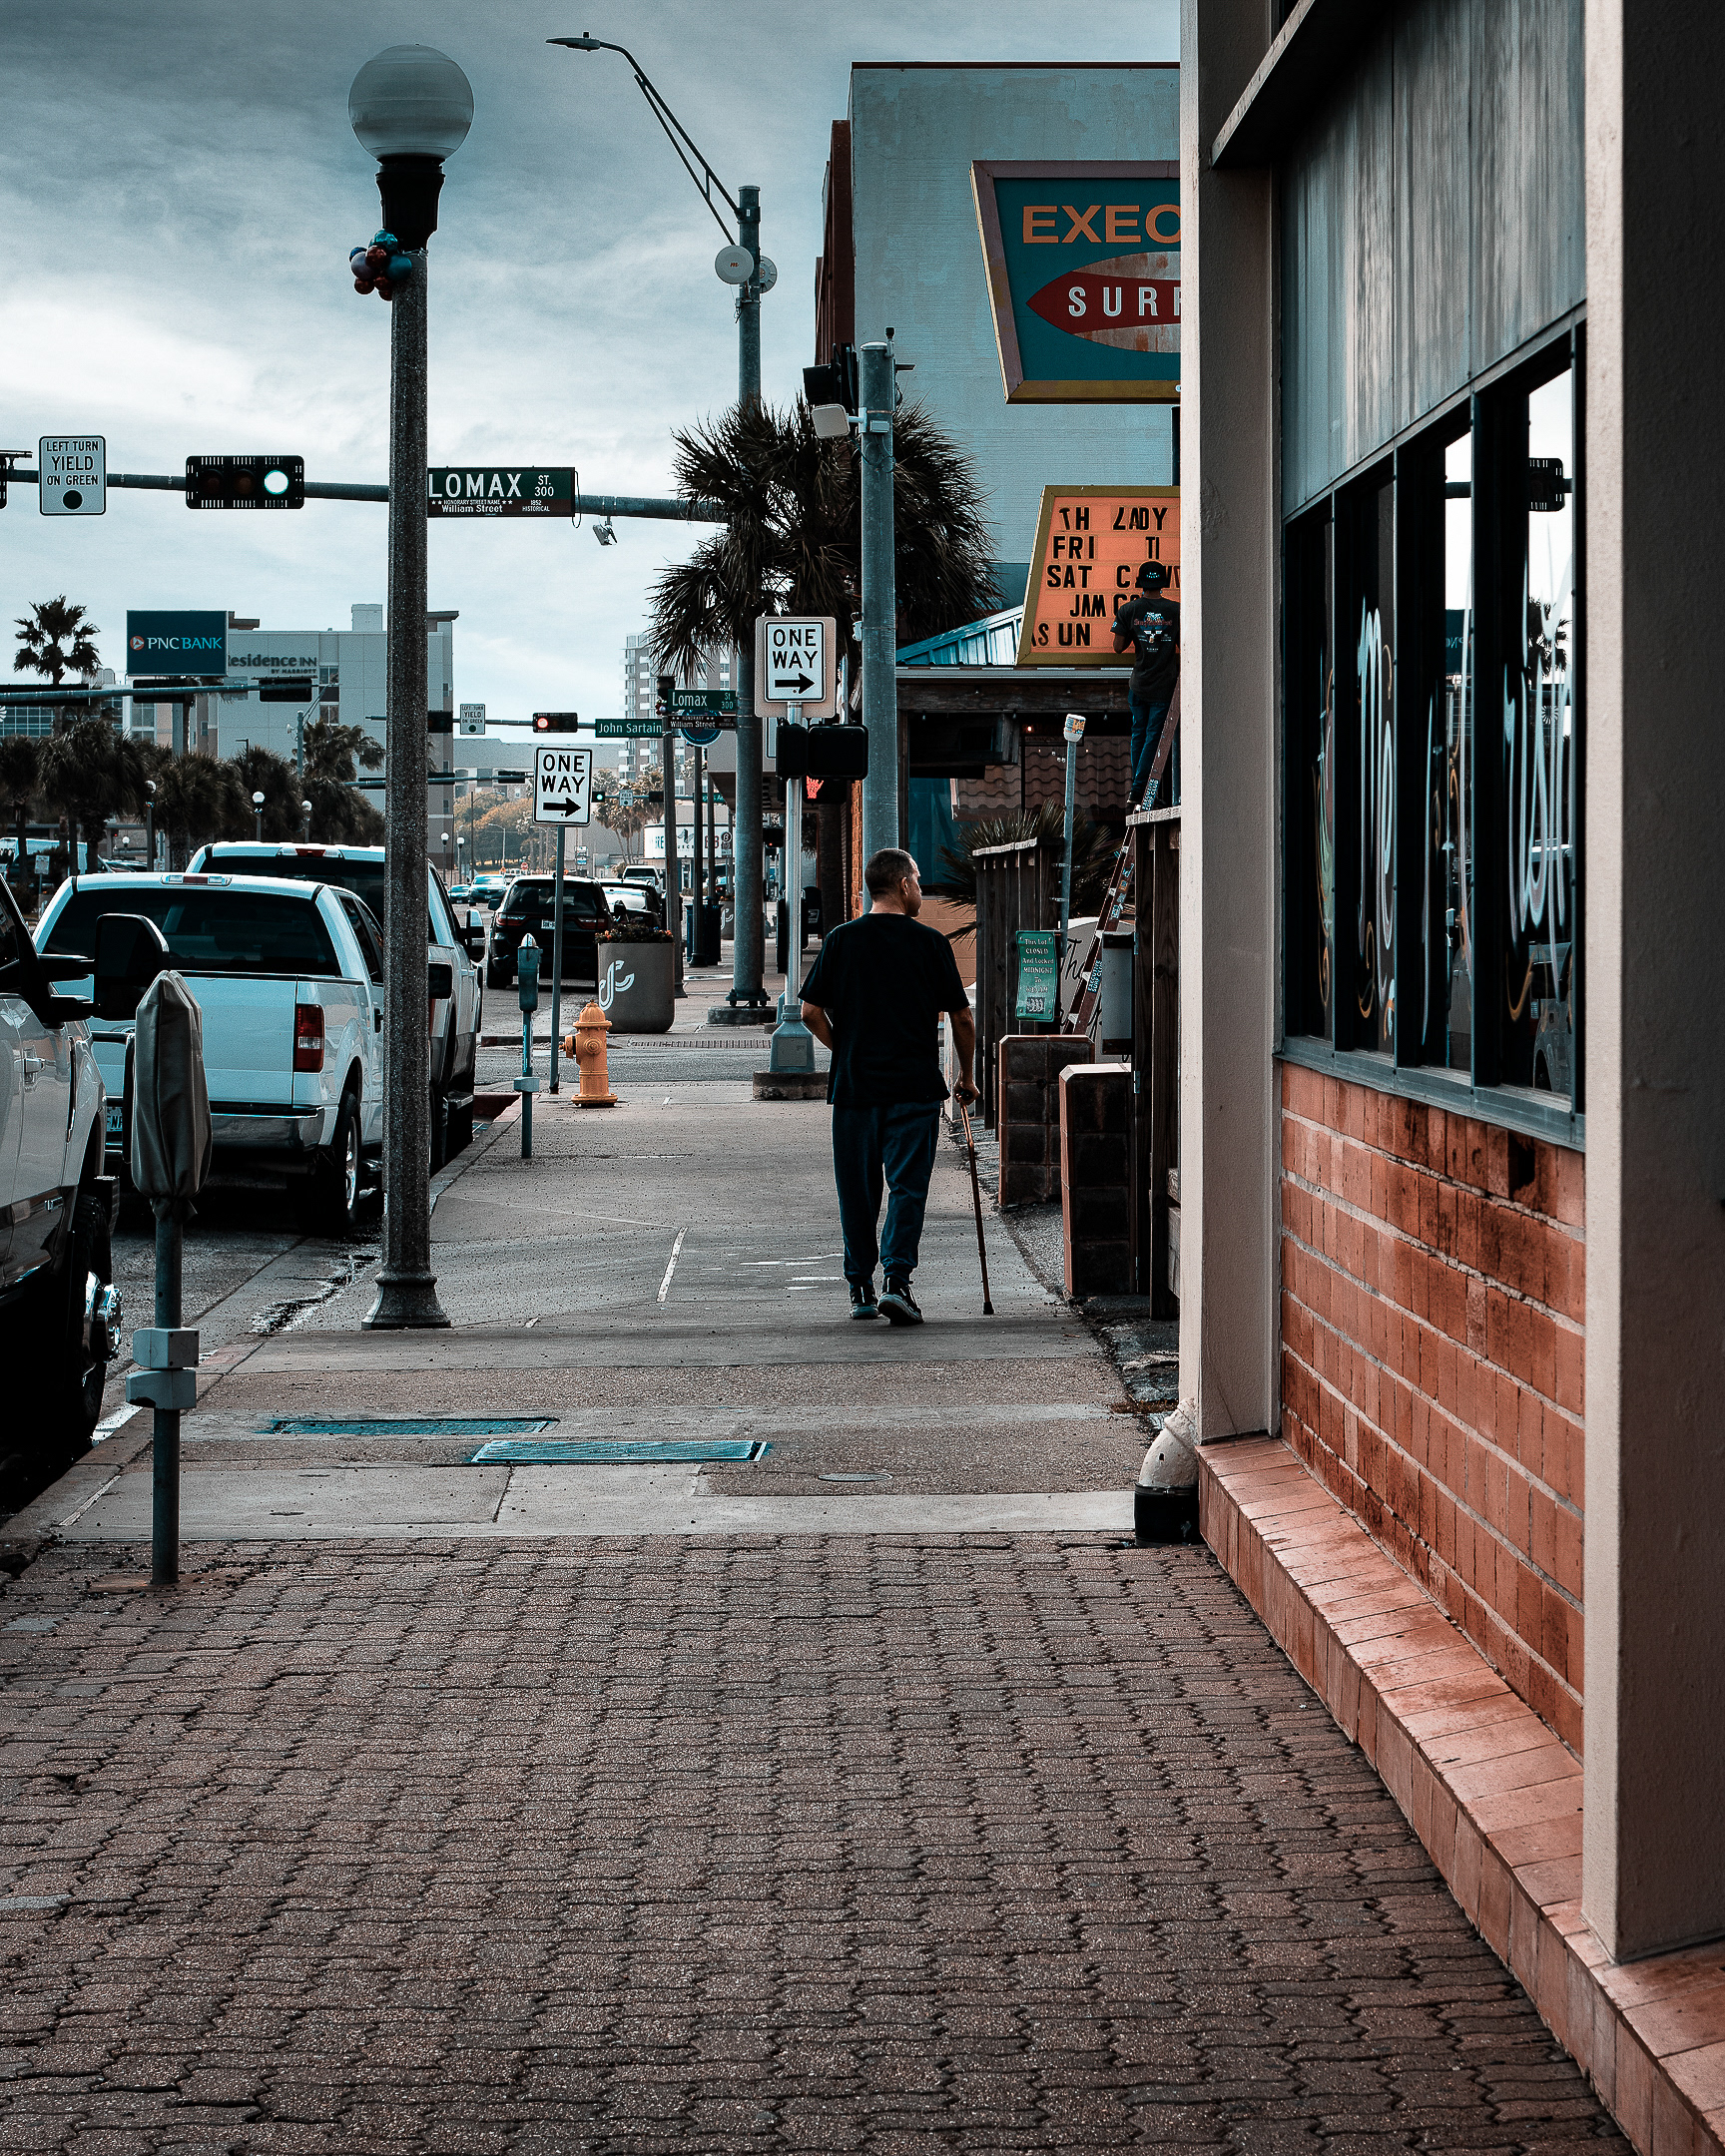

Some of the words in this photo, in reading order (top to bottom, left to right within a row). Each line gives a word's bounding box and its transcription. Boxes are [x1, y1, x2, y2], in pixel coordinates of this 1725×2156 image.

[47, 441, 69, 451] LEFT
[73, 441, 98, 451] TURN
[52, 456, 93, 470] YIELD
[47, 475, 60, 485] ON
[66, 475, 98, 485] GREEN
[429, 474, 521, 497] LOMAX
[535, 487, 554, 496] 300
[1059, 507, 1089, 530] TH
[1113, 507, 1168, 530] LADY
[1053, 536, 1094, 559] FRI
[1047, 565, 1092, 588] SAT
[147, 637, 179, 649] PNC
[182, 637, 222, 649] BANK
[773, 629, 816, 647] ONE
[300, 657, 317, 666] INN
[772, 651, 818, 669] WAY
[672, 692, 707, 706] Lomax
[599, 723, 622, 733] John
[626, 722, 661, 733] Sartain
[543, 754, 584, 773] ONE
[541, 776, 585, 793] WAY
